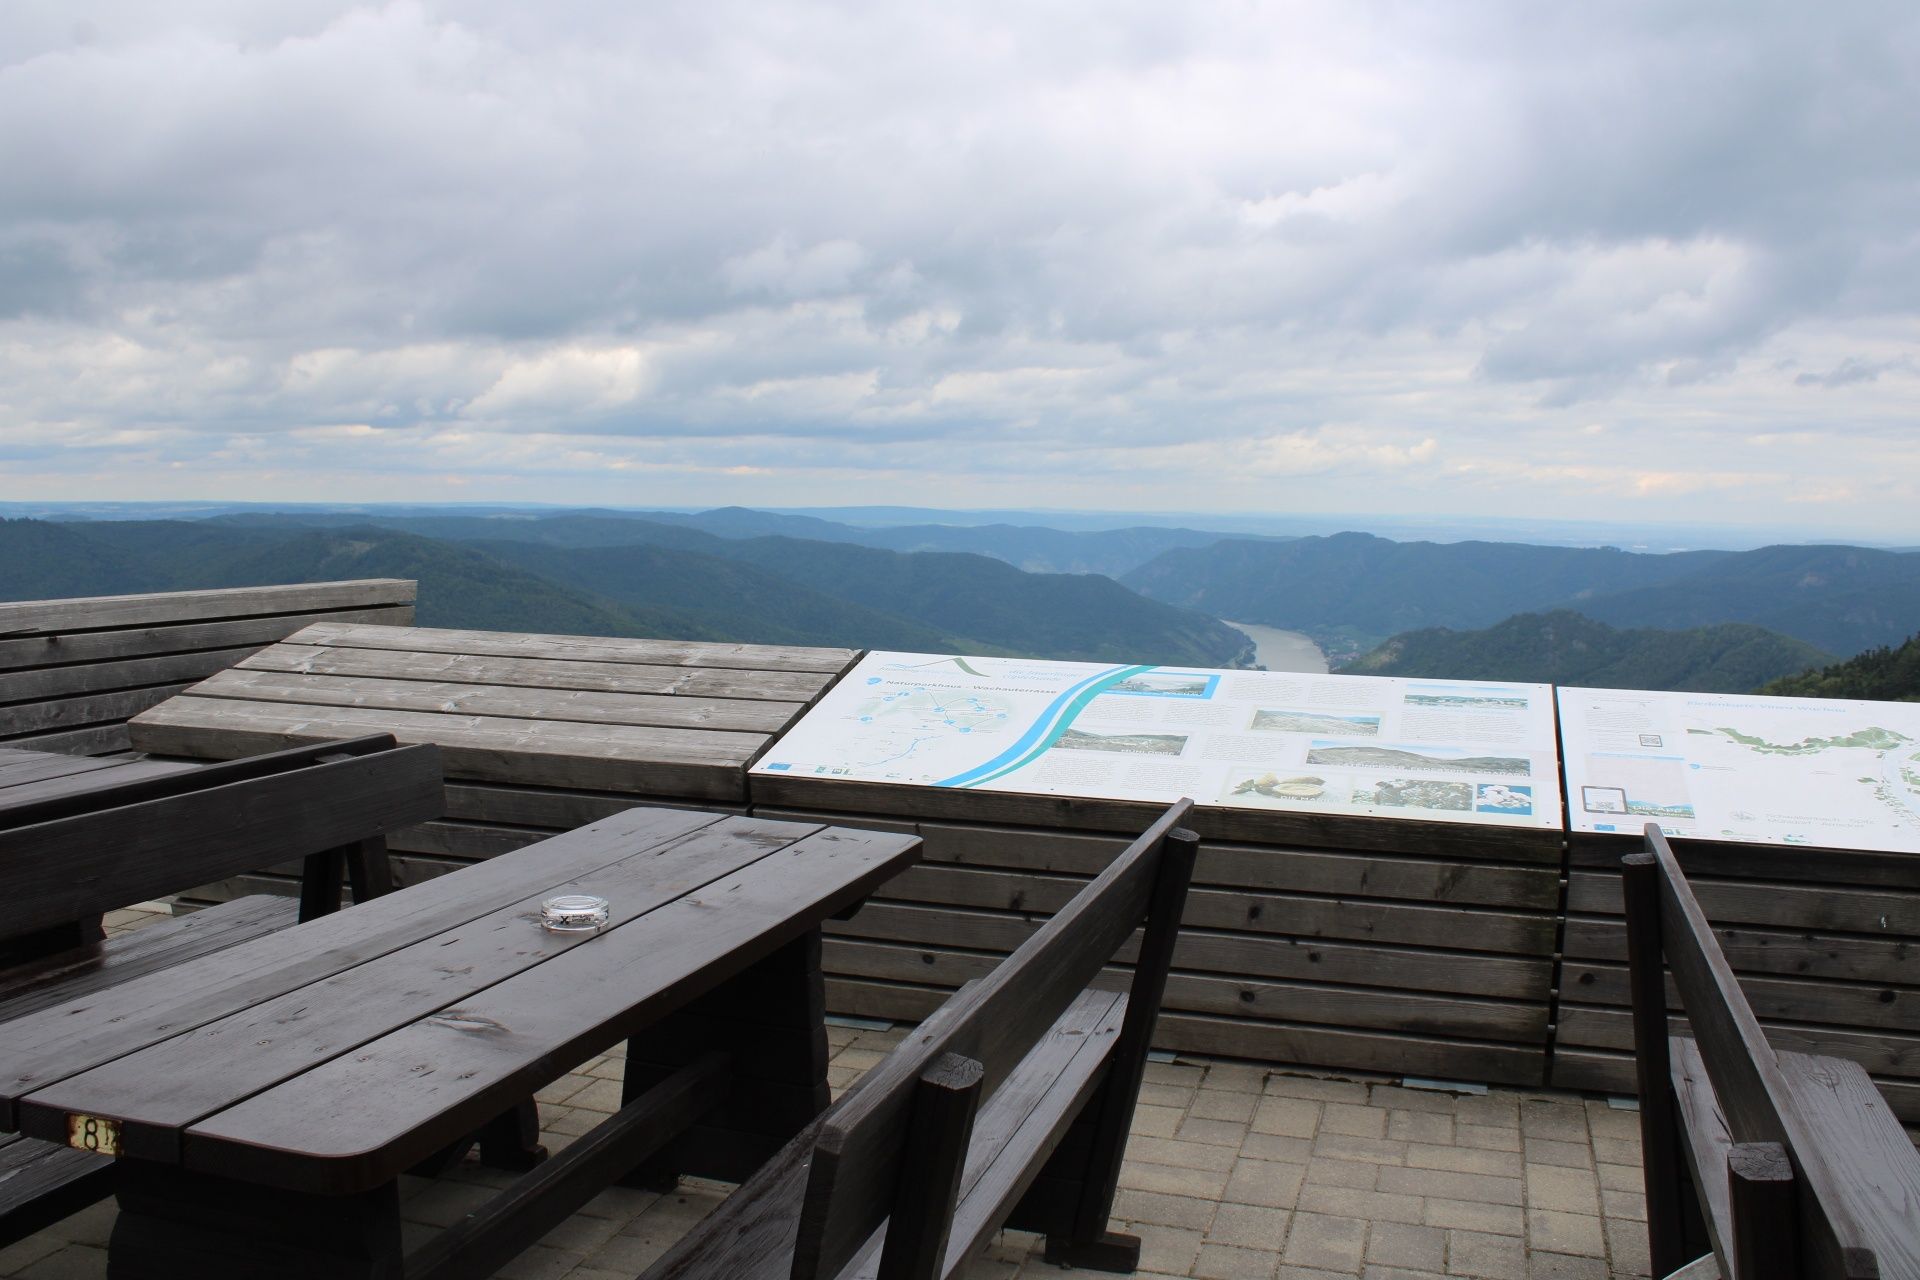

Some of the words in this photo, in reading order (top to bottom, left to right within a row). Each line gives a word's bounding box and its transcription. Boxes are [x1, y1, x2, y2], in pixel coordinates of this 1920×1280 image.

[885, 679, 962, 689] Naturparkhaus
[973, 685, 1058, 695] Wachauterrasse
[84, 1118, 98, 1151] 8
